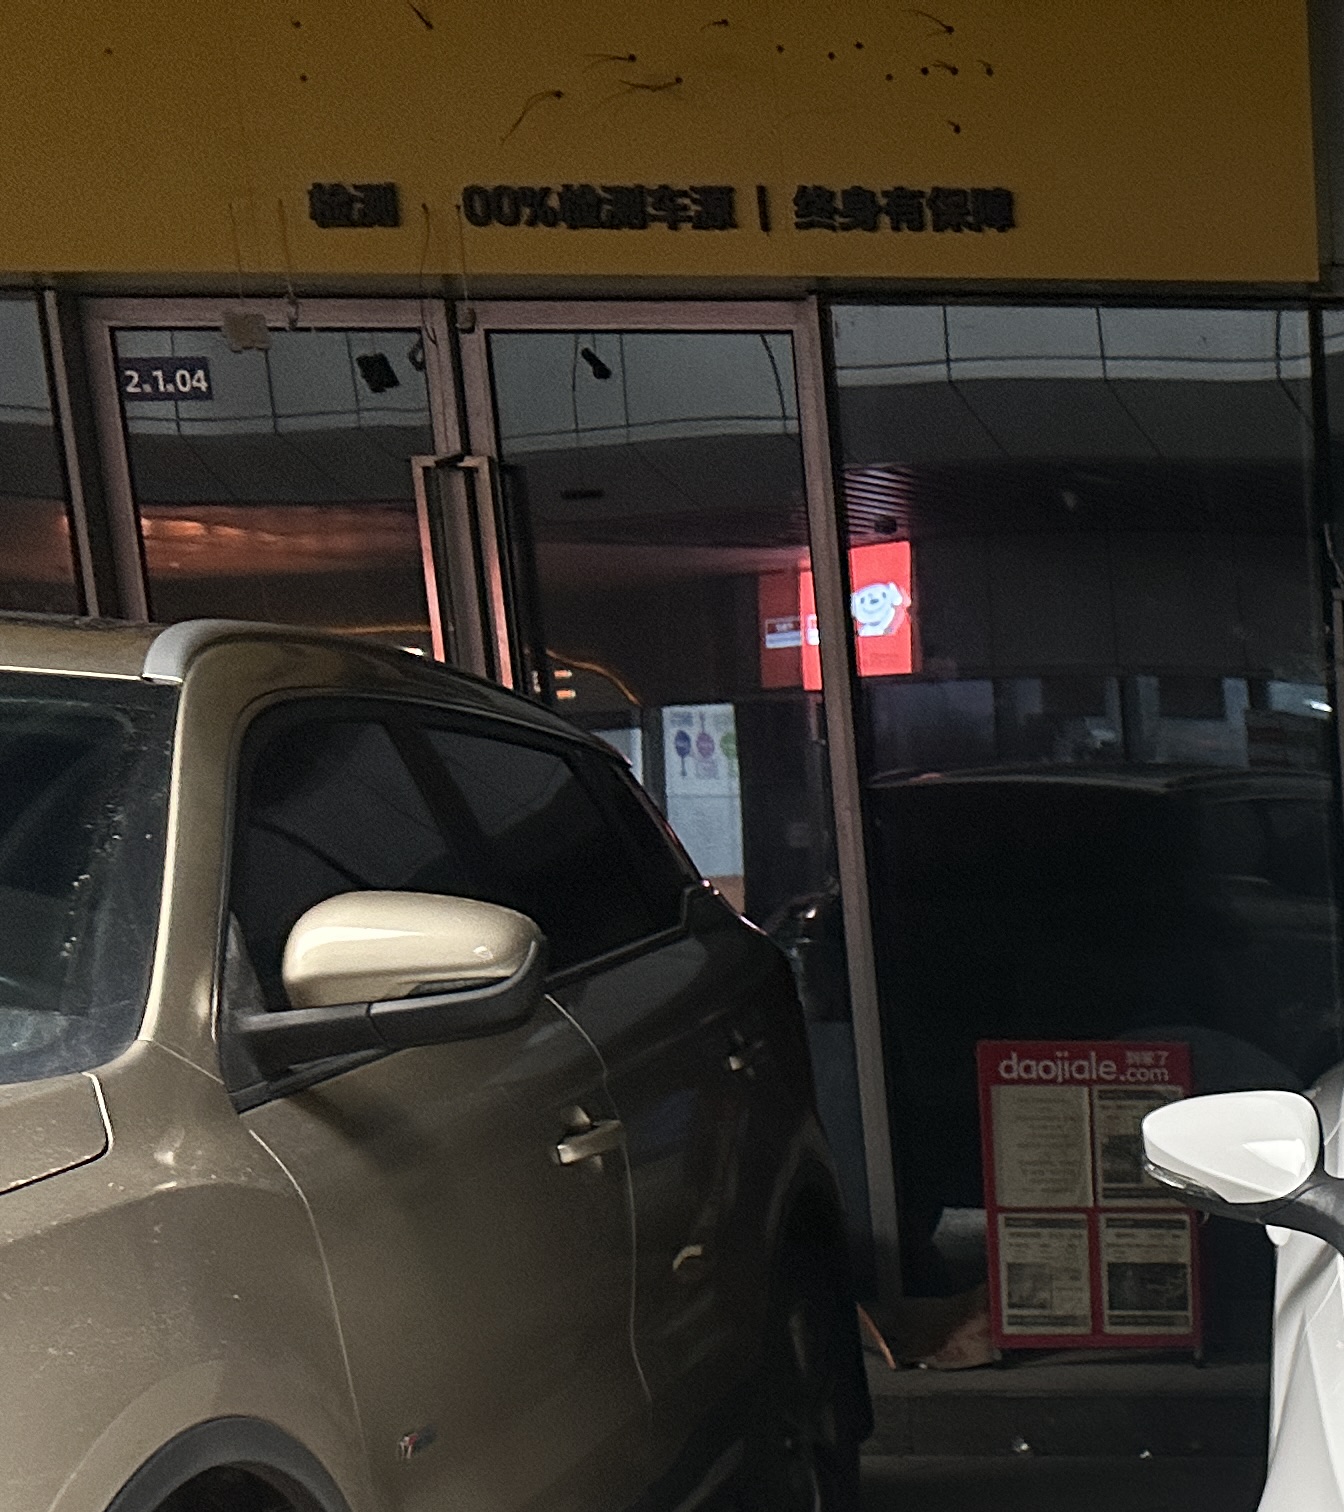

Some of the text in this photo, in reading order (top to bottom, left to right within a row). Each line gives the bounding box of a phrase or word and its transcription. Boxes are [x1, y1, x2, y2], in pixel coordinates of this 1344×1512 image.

[308, 181, 400, 228] 检测
[794, 185, 1016, 232] 终身有保障
[124, 369, 208, 394] 2.1.04
